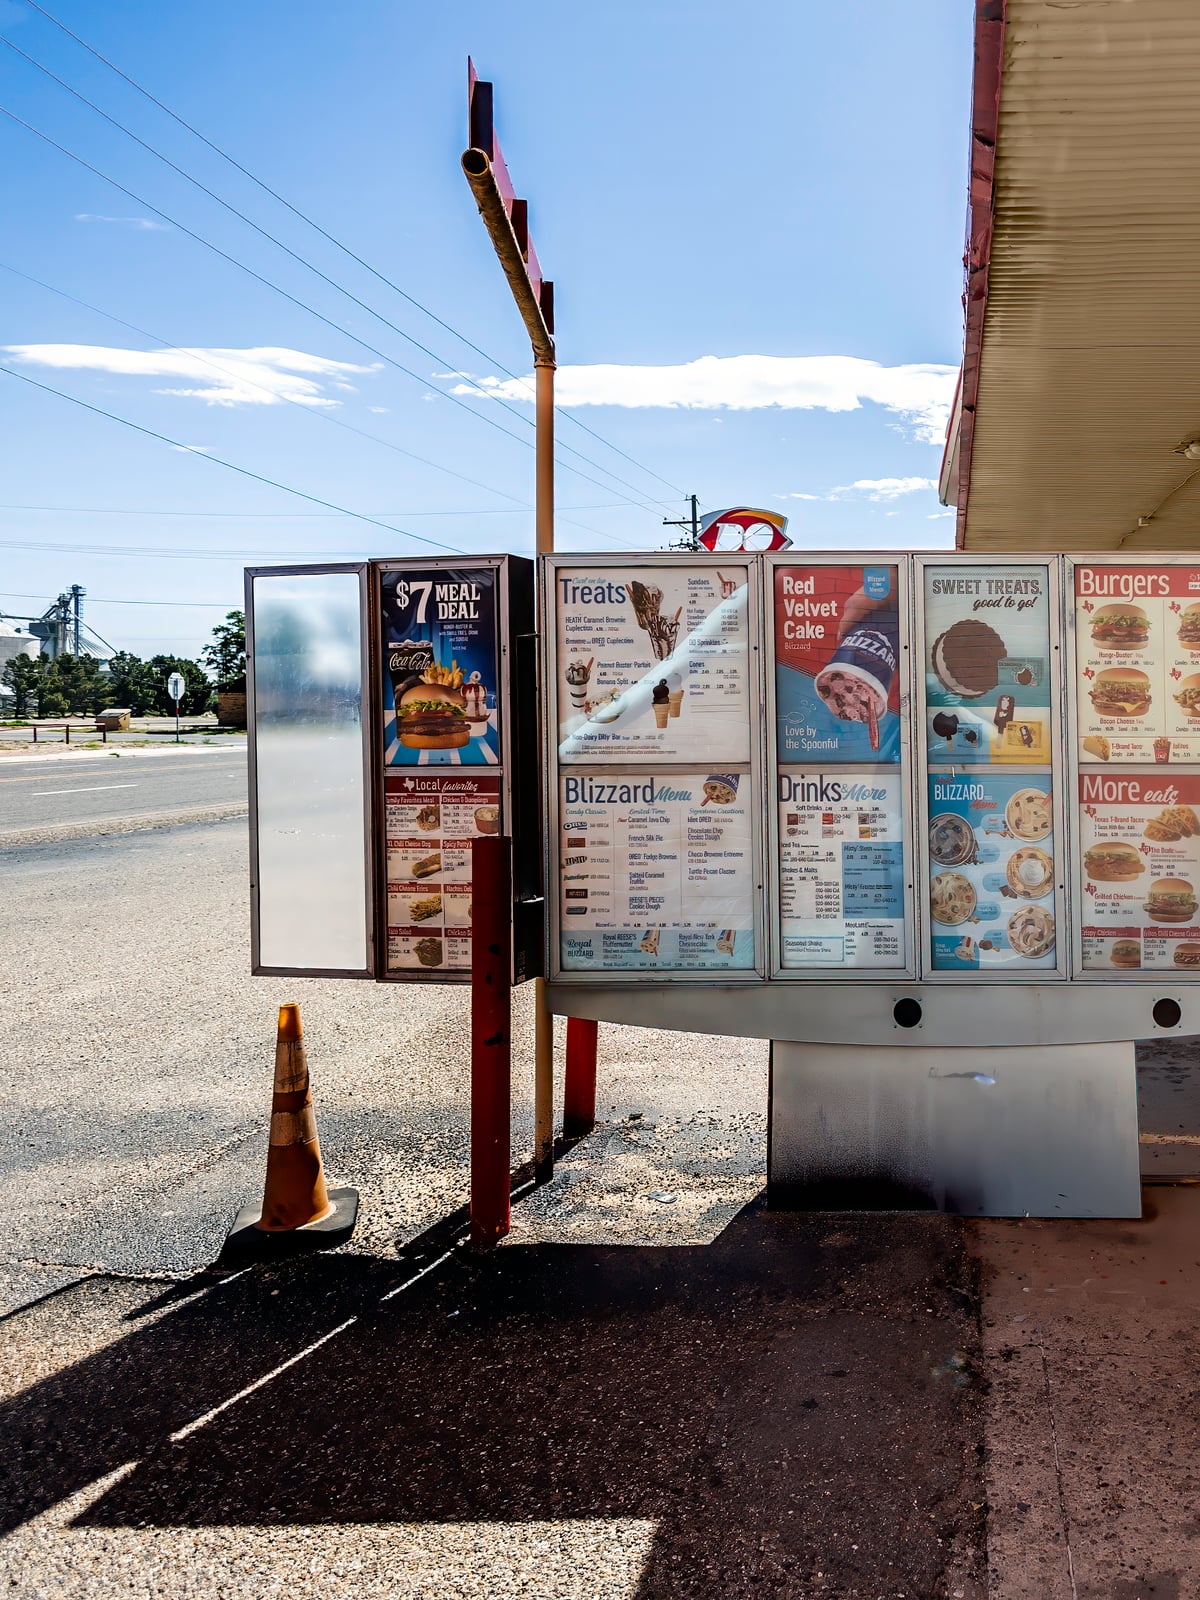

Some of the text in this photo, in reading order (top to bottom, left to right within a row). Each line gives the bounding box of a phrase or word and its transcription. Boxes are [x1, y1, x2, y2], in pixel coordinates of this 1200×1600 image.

[435, 584, 480, 601] MEAL
[560, 578, 626, 604] Treats
[783, 576, 815, 595] Red
[932, 579, 1043, 596] SWEET TREATS,
[1080, 568, 1170, 602] Burgers
[396, 580, 433, 623] $7
[783, 598, 838, 617] Velvet
[973, 595, 1039, 611] good to go!
[438, 602, 479, 619] DEAL
[783, 621, 825, 639] Cake
[785, 642, 811, 650] Blizzard
[389, 651, 431, 671] Coca-Cola
[785, 725, 816, 738] Love by
[785, 738, 839, 751] the Spoonful
[416, 779, 478, 793] Local favorites
[565, 777, 692, 804] Blizzard Menu
[779, 774, 841, 802] Drinks
[843, 784, 887, 801] More
[934, 784, 984, 800] BLIZZARD
[1083, 775, 1179, 806] More eats
[705, 834, 720, 842] Dough
